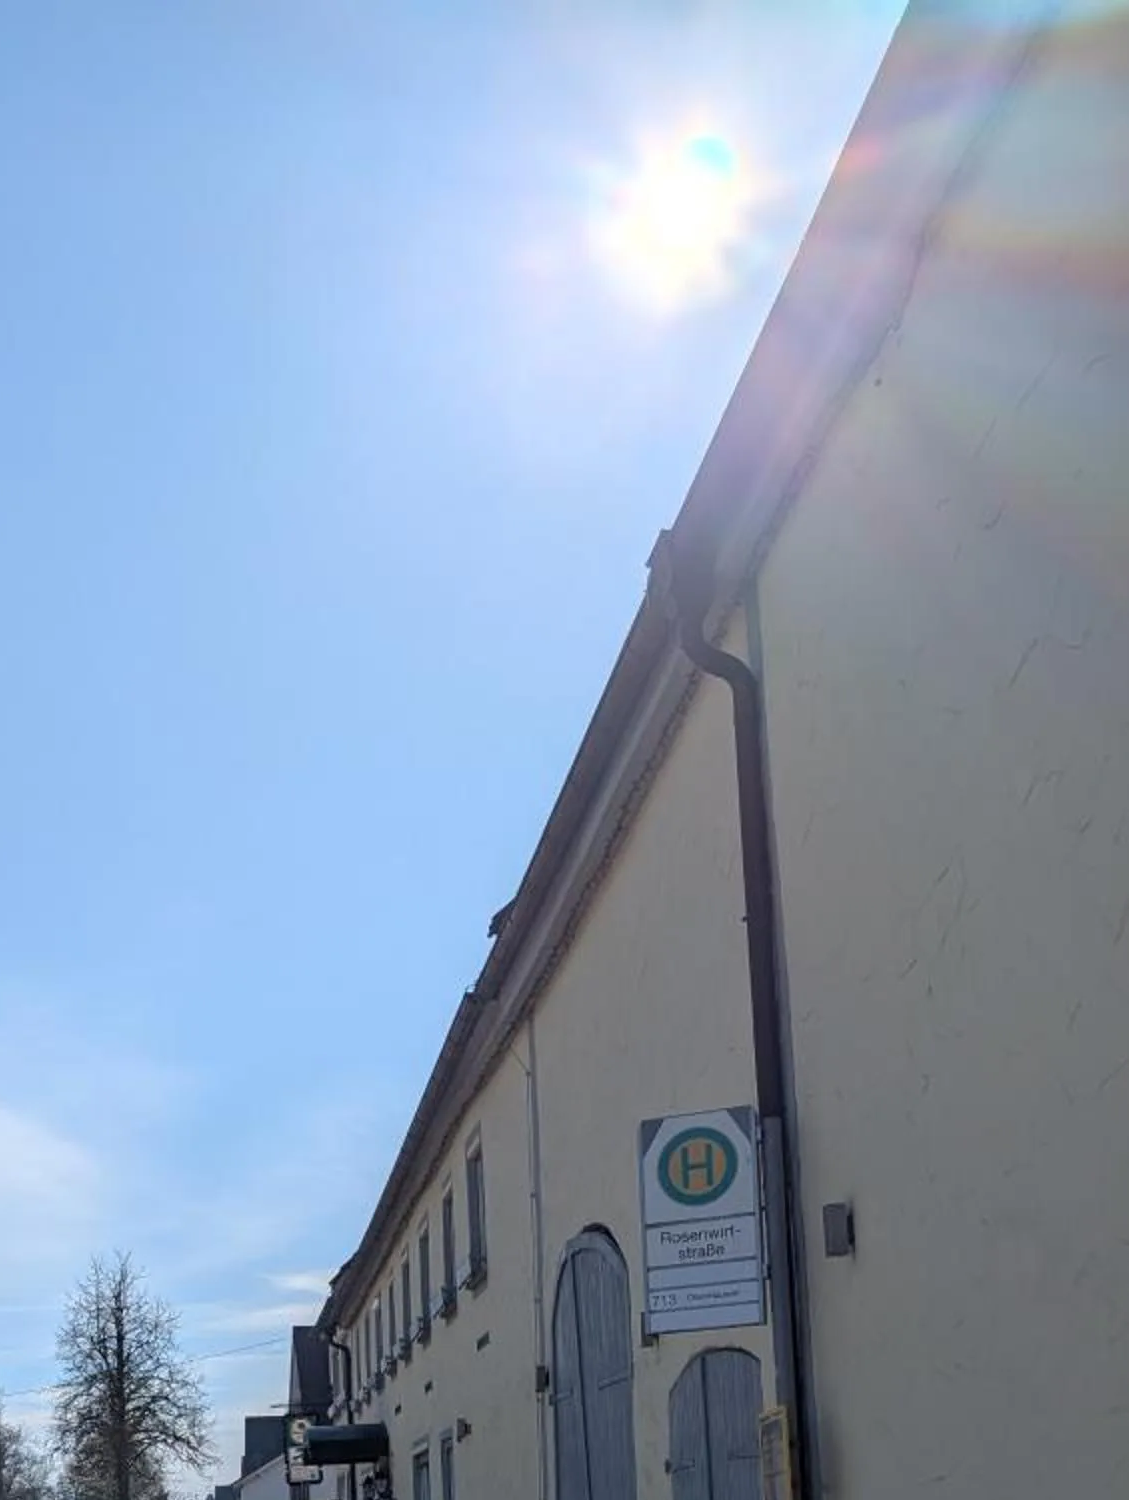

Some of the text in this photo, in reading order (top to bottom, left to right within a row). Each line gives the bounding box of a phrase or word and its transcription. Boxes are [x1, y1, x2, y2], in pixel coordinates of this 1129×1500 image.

[680, 1143, 714, 1189] H
[660, 1224, 741, 1245] Rosenwirt-
[678, 1243, 725, 1261] straße
